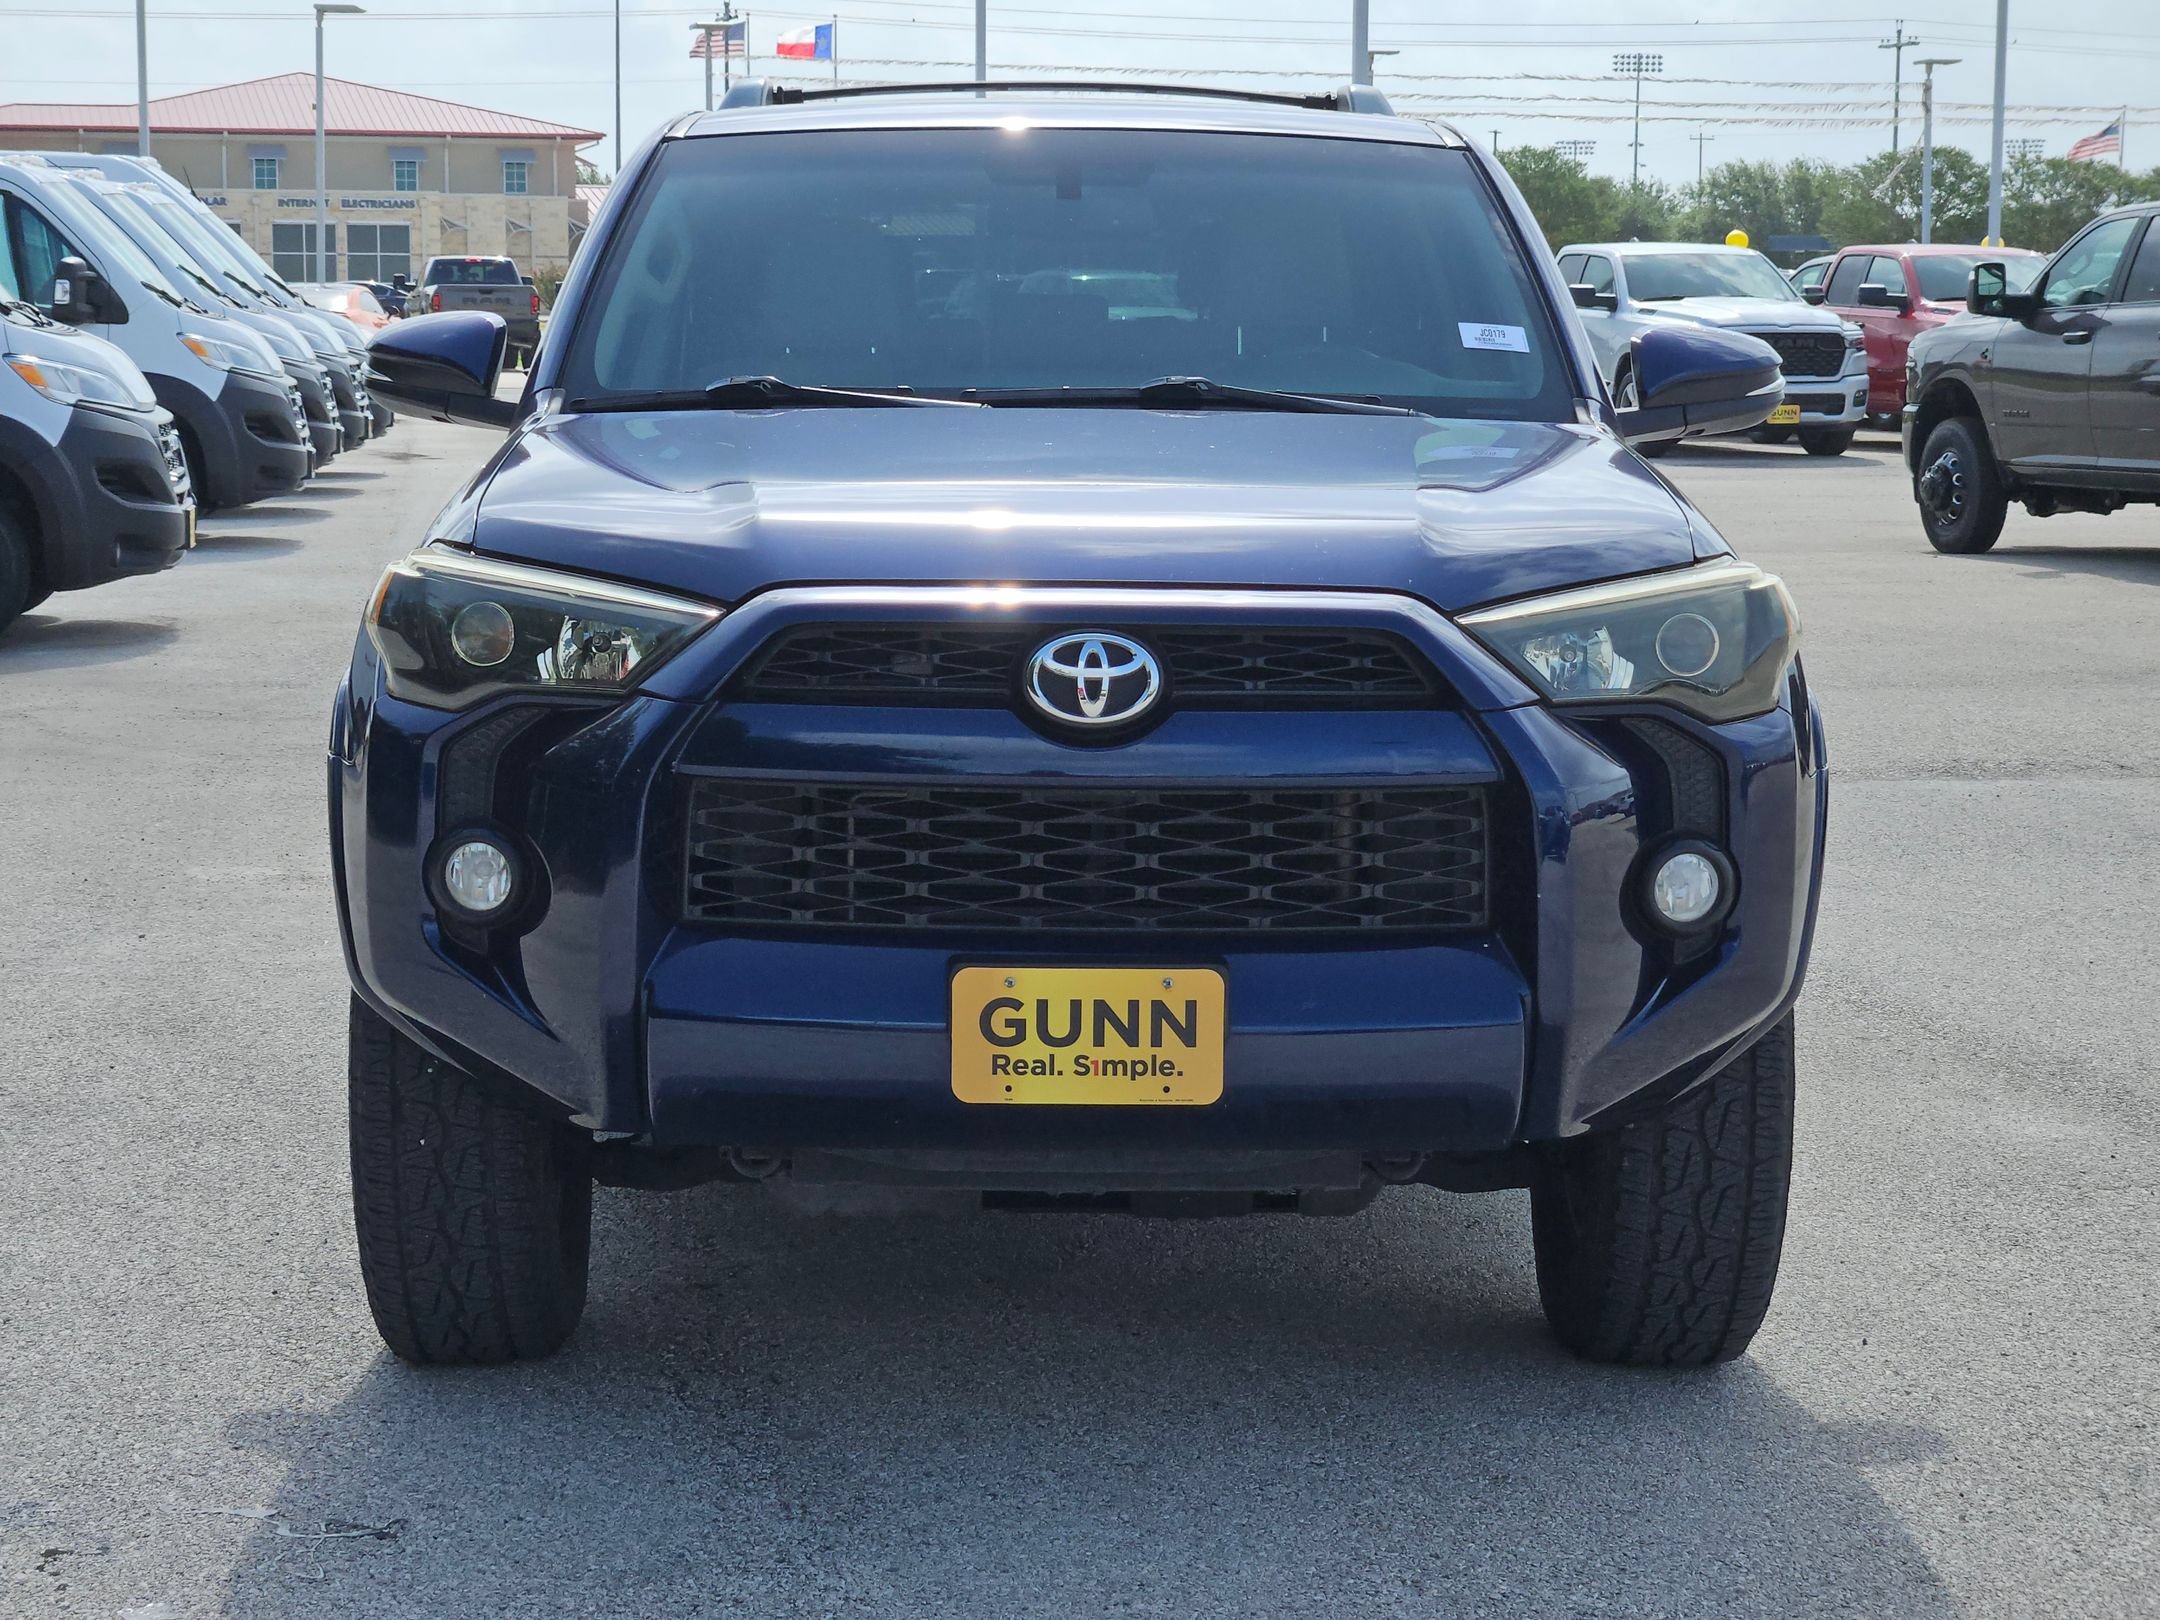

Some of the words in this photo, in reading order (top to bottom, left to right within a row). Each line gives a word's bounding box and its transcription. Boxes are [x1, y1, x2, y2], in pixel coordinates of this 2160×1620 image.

[277, 199, 330, 208] INTERNT
[341, 199, 415, 209] ELECTRICIANS
[979, 996, 1197, 1048] GUNN
[991, 1053, 1063, 1076] Real.
